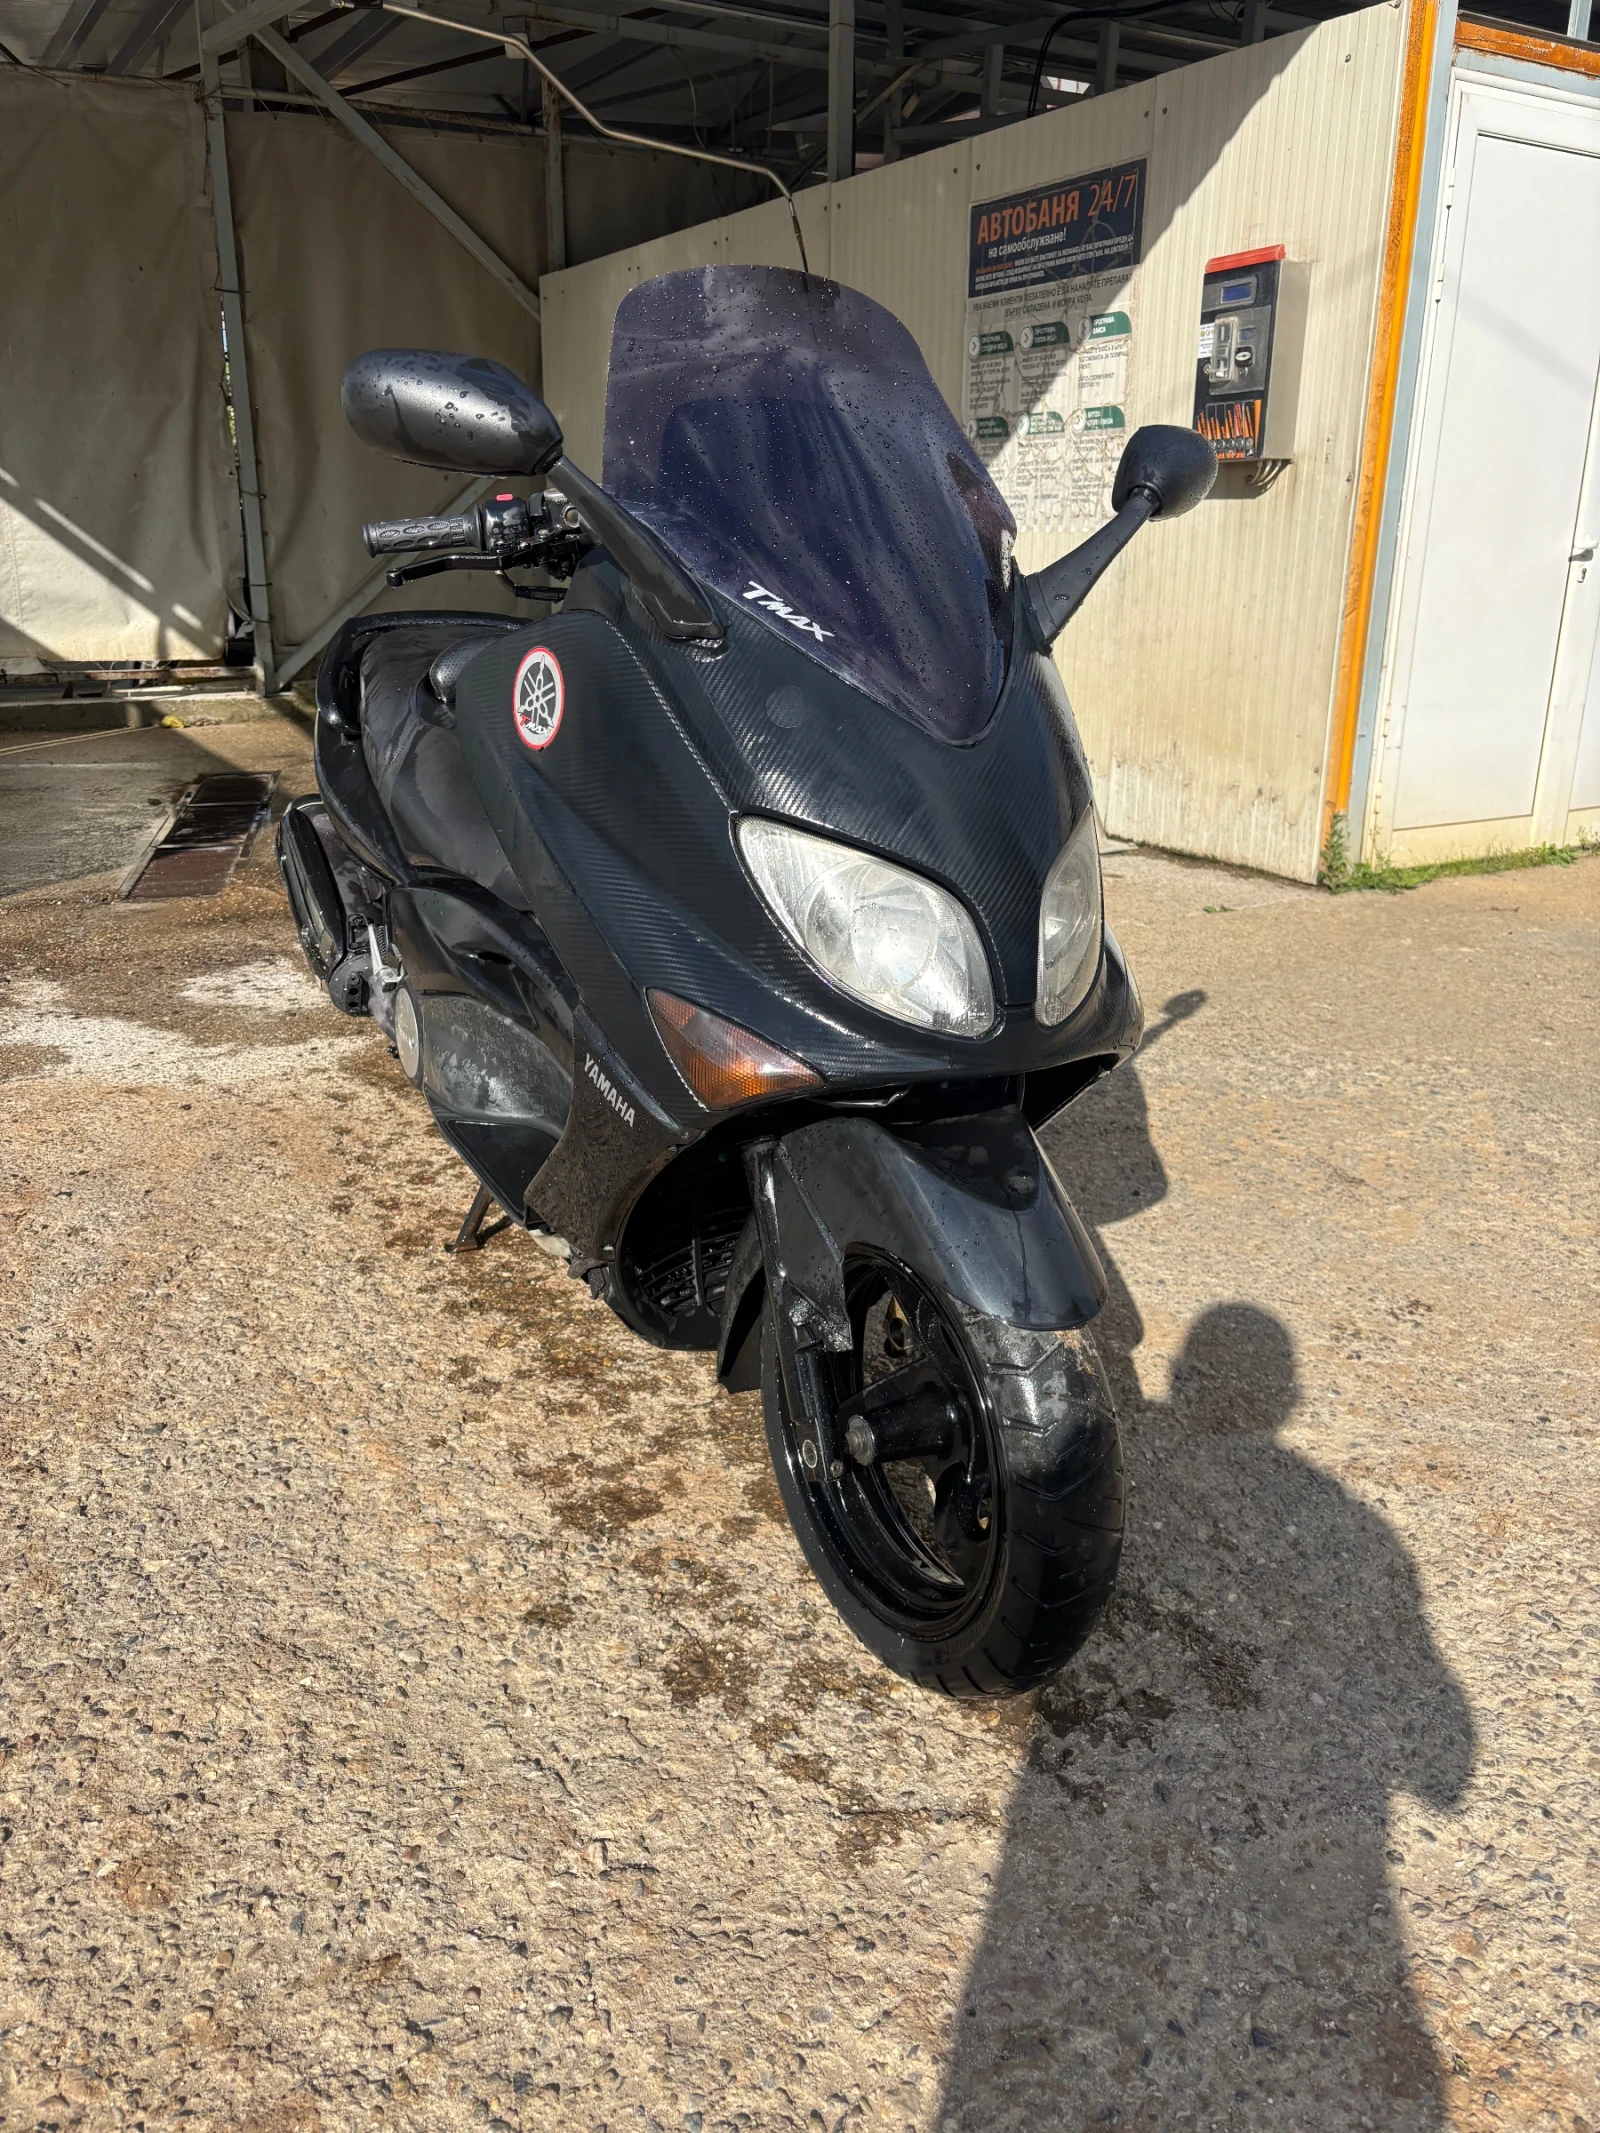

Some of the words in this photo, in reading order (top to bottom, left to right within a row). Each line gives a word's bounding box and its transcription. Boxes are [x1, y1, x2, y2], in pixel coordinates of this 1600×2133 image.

[977, 190, 1080, 245] АВТОБАНЯ
[1088, 174, 1137, 217] 24/7
[988, 246, 998, 259] на
[998, 227, 1067, 255] самообслужване!
[742, 580, 835, 642] TMAX
[519, 713, 552, 738] TMAX
[584, 1052, 636, 1128] YAMAHA
